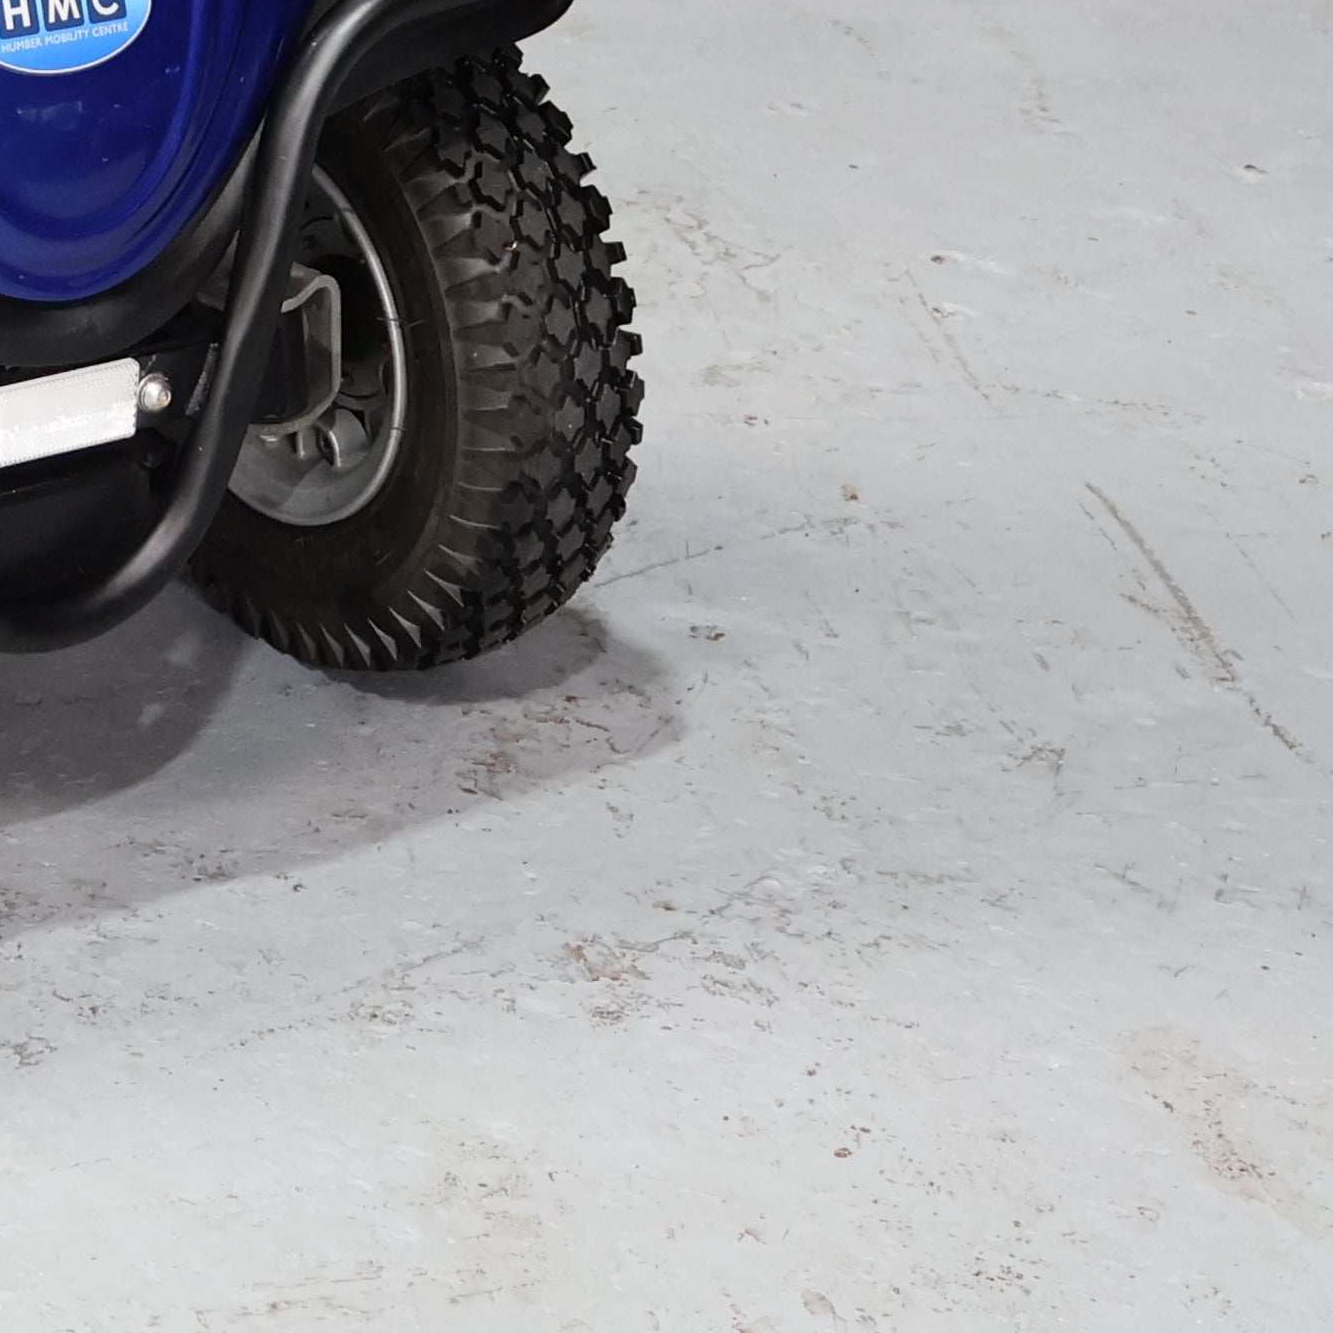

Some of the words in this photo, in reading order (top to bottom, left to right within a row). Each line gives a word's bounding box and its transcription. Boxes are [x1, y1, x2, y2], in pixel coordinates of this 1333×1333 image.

[0, 37, 43, 53] HUMBER
[45, 29, 89, 46] MOBILITY
[92, 21, 130, 37] CENTRE
